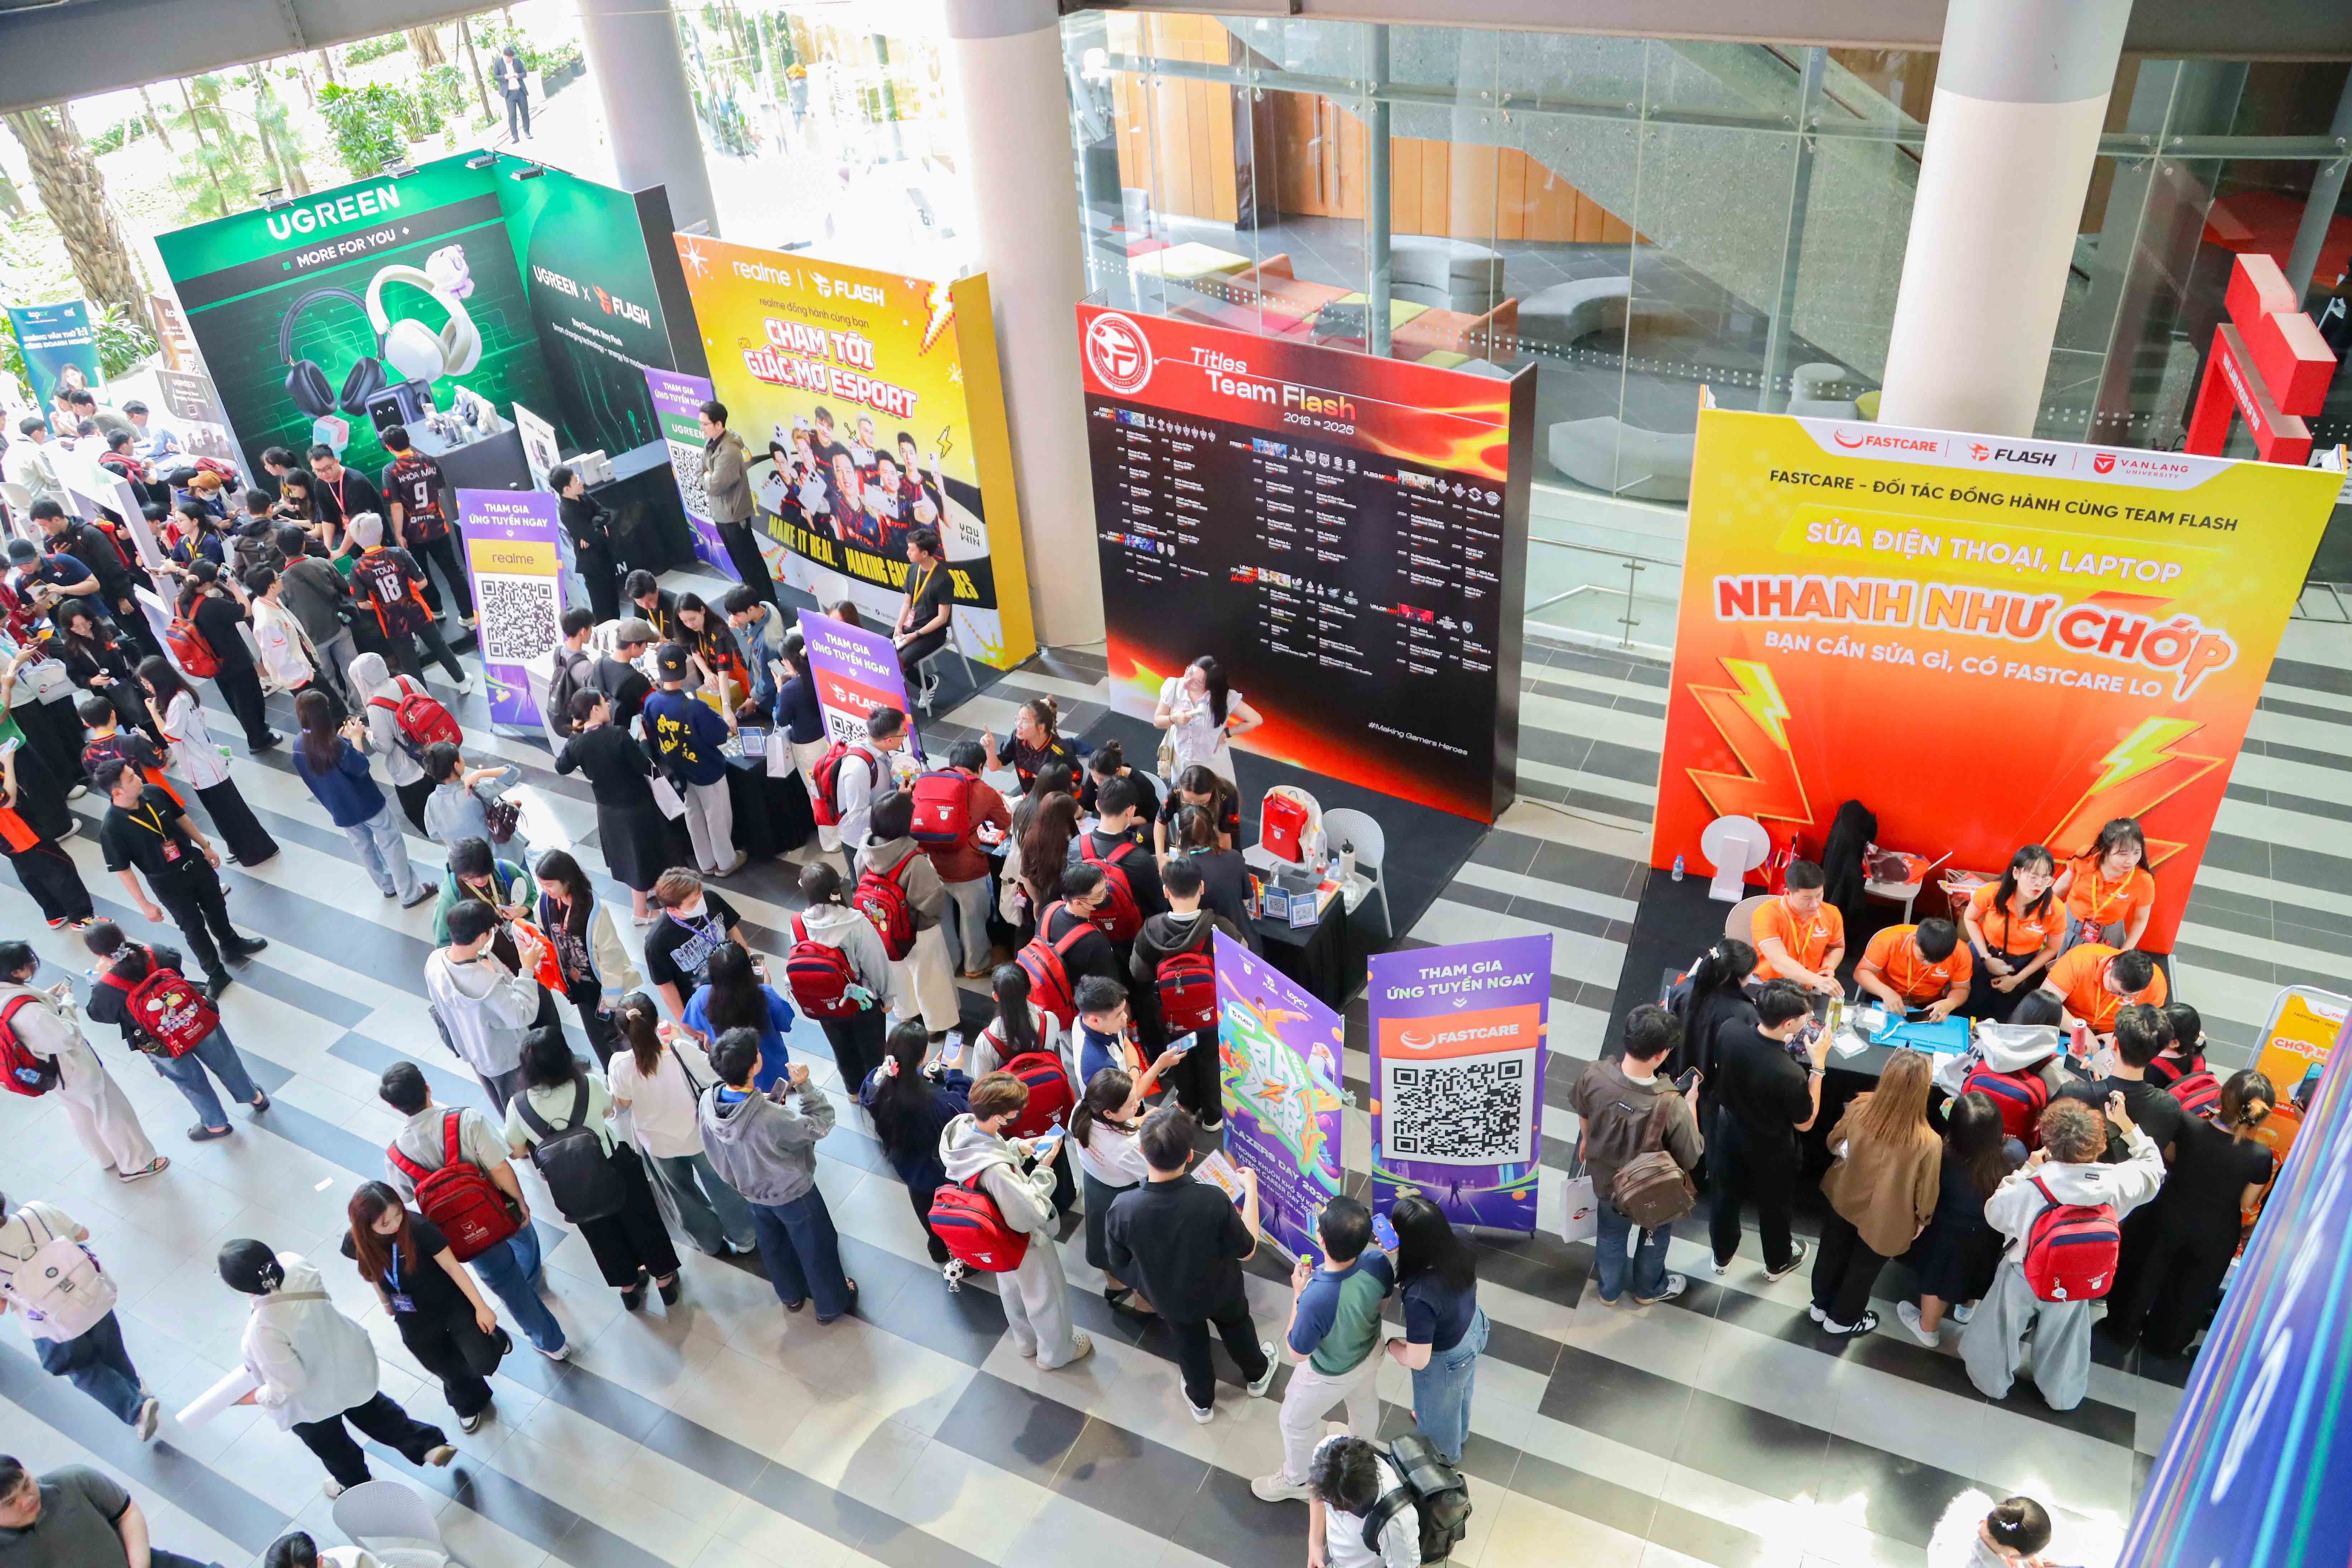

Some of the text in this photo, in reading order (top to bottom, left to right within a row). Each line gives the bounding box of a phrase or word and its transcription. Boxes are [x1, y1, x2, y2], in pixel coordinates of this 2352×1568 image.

[266, 184, 401, 240] UGREEN
[296, 229, 396, 268] MORE FOR YOU
[733, 260, 884, 307] realme FLASH
[533, 264, 651, 329] UGREEN FLASH
[759, 297, 869, 329] realme đồng hành cùng bạn
[765, 318, 875, 370] CHẠM TỚI
[1191, 346, 1247, 374] Titles
[663, 382, 694, 395] THAM GIA
[743, 344, 917, 419] GIẤC MƠ ESPORT
[1205, 369, 1356, 421] Team Flash
[671, 423, 705, 440] UGREEN
[1283, 412, 1354, 435] 2018 2025
[1866, 435, 1938, 452] FASTCARE
[1994, 448, 2057, 467] FLASH
[2121, 459, 2188, 473] VANLANG
[398, 472, 419, 483] KHOA
[1378, 474, 1398, 482] MOBILE
[2126, 470, 2179, 479] UNIVERSITY
[414, 481, 429, 510] 9
[1770, 470, 2238, 531] FASTCARE ĐỐI TÁC ĐỒNG HÀNH CÙNG TEAM FLASH
[469, 513, 548, 527] ỨNG TUYỂN NGAY
[484, 503, 530, 514] THAM GIA
[959, 523, 979, 537] YOU
[960, 534, 980, 547] WIN
[492, 553, 534, 564] realme
[767, 514, 886, 584] MAKE IT REAL. MAKING
[1805, 518, 2182, 583] SỬA ĐIỆN THOẠI, LAPTOP
[372, 563, 395, 576] TDUY
[376, 573, 402, 603] 18
[1369, 603, 1398, 613] VALORANT
[825, 632, 871, 657] THAM GIA
[1716, 577, 2232, 697] NHANH NHƯ CHỚP
[812, 639, 889, 676] ỨNG TUYỂN NGAY
[1765, 631, 2161, 697] BẠN CẦN SỬA GÌ, CÓ FASTCARE LO
[1368, 722, 1468, 756] #Making Gamers Heroes
[1419, 960, 1503, 980] THAM GIA
[1263, 982, 1278, 995] FLASH
[1387, 972, 1534, 1000] ỨNG TUYỂN NGAY
[1287, 989, 1308, 1008] topcv
[1238, 1015, 1252, 1028] FLASH
[1438, 1024, 1519, 1044] FASTCARE
[2275, 1039, 2314, 1056] CHỚP
[1226, 1118, 1276, 1162] FLAZERS
[1278, 1160, 1299, 1181] DAY
[1235, 1142, 1257, 1162] TRONG
[1258, 1161, 1281, 1180] KHUÔN
[1238, 1152, 1260, 1173] VLTECH
[1262, 1171, 1286, 1193] CAREER
[1286, 1191, 1299, 1206] DAY
[1294, 1206, 1305, 1218] LANG
